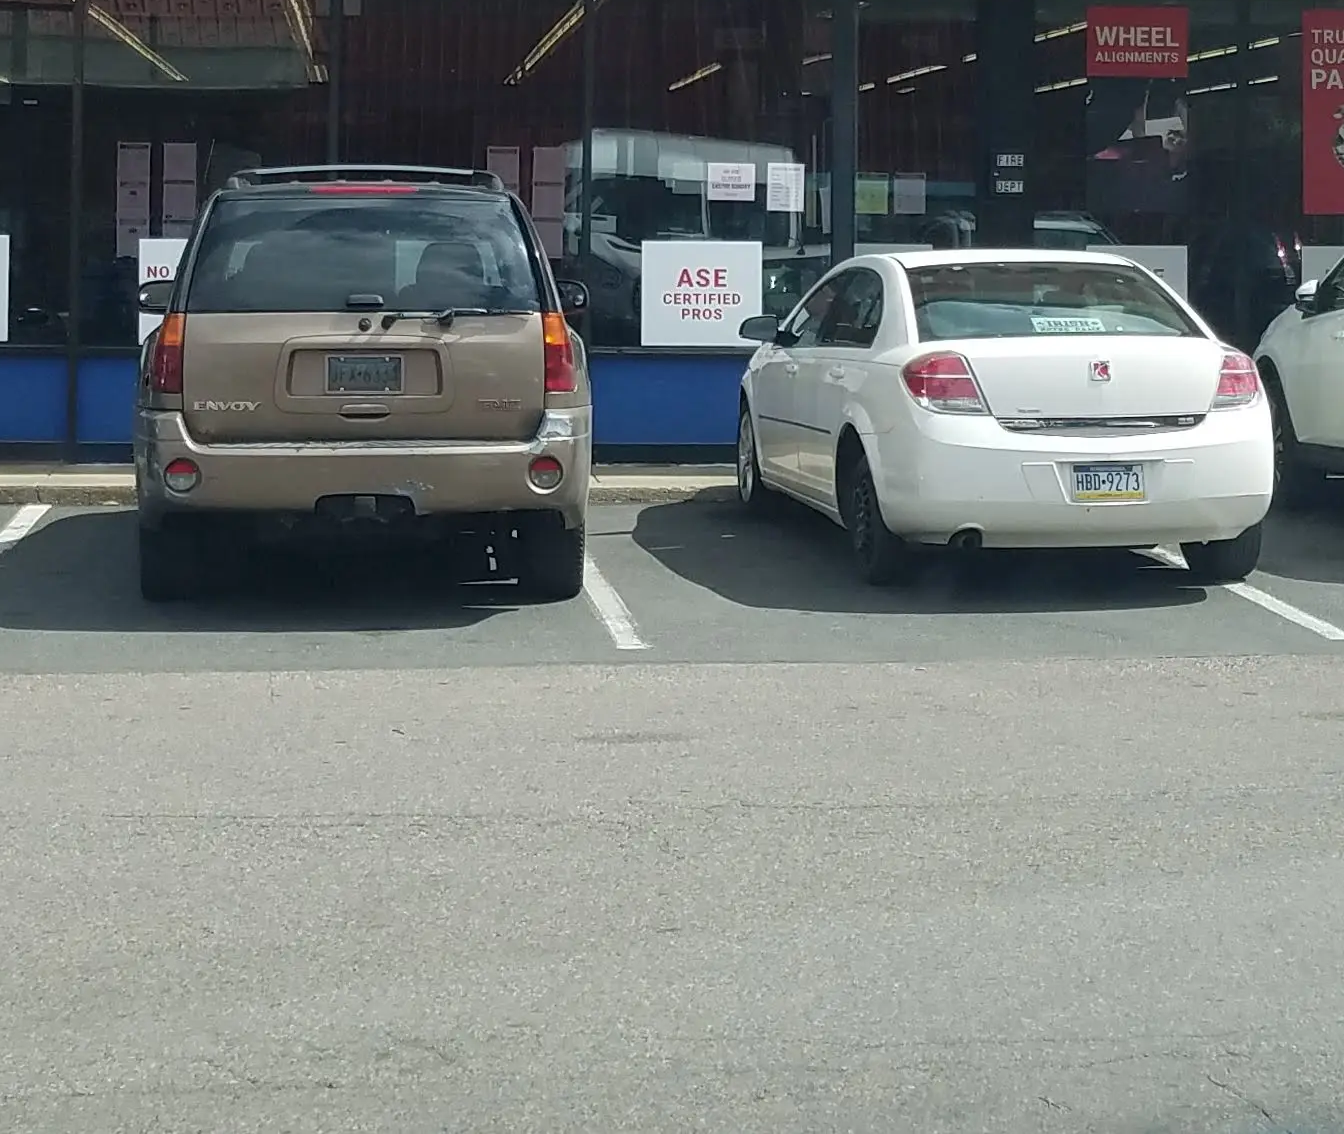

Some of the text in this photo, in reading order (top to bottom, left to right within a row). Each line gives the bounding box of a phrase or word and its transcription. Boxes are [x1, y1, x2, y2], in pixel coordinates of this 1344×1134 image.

[1095, 26, 1179, 47] WHEEL
[1095, 51, 1179, 63] ALIGNMENTS
[997, 154, 1024, 166] FIRE
[996, 181, 1023, 193] DEPT
[147, 266, 170, 278] NO
[676, 268, 727, 287] ASE
[663, 293, 741, 305] CERTIFIED
[681, 308, 723, 320] PROS
[193, 400, 261, 411] ENVOY
